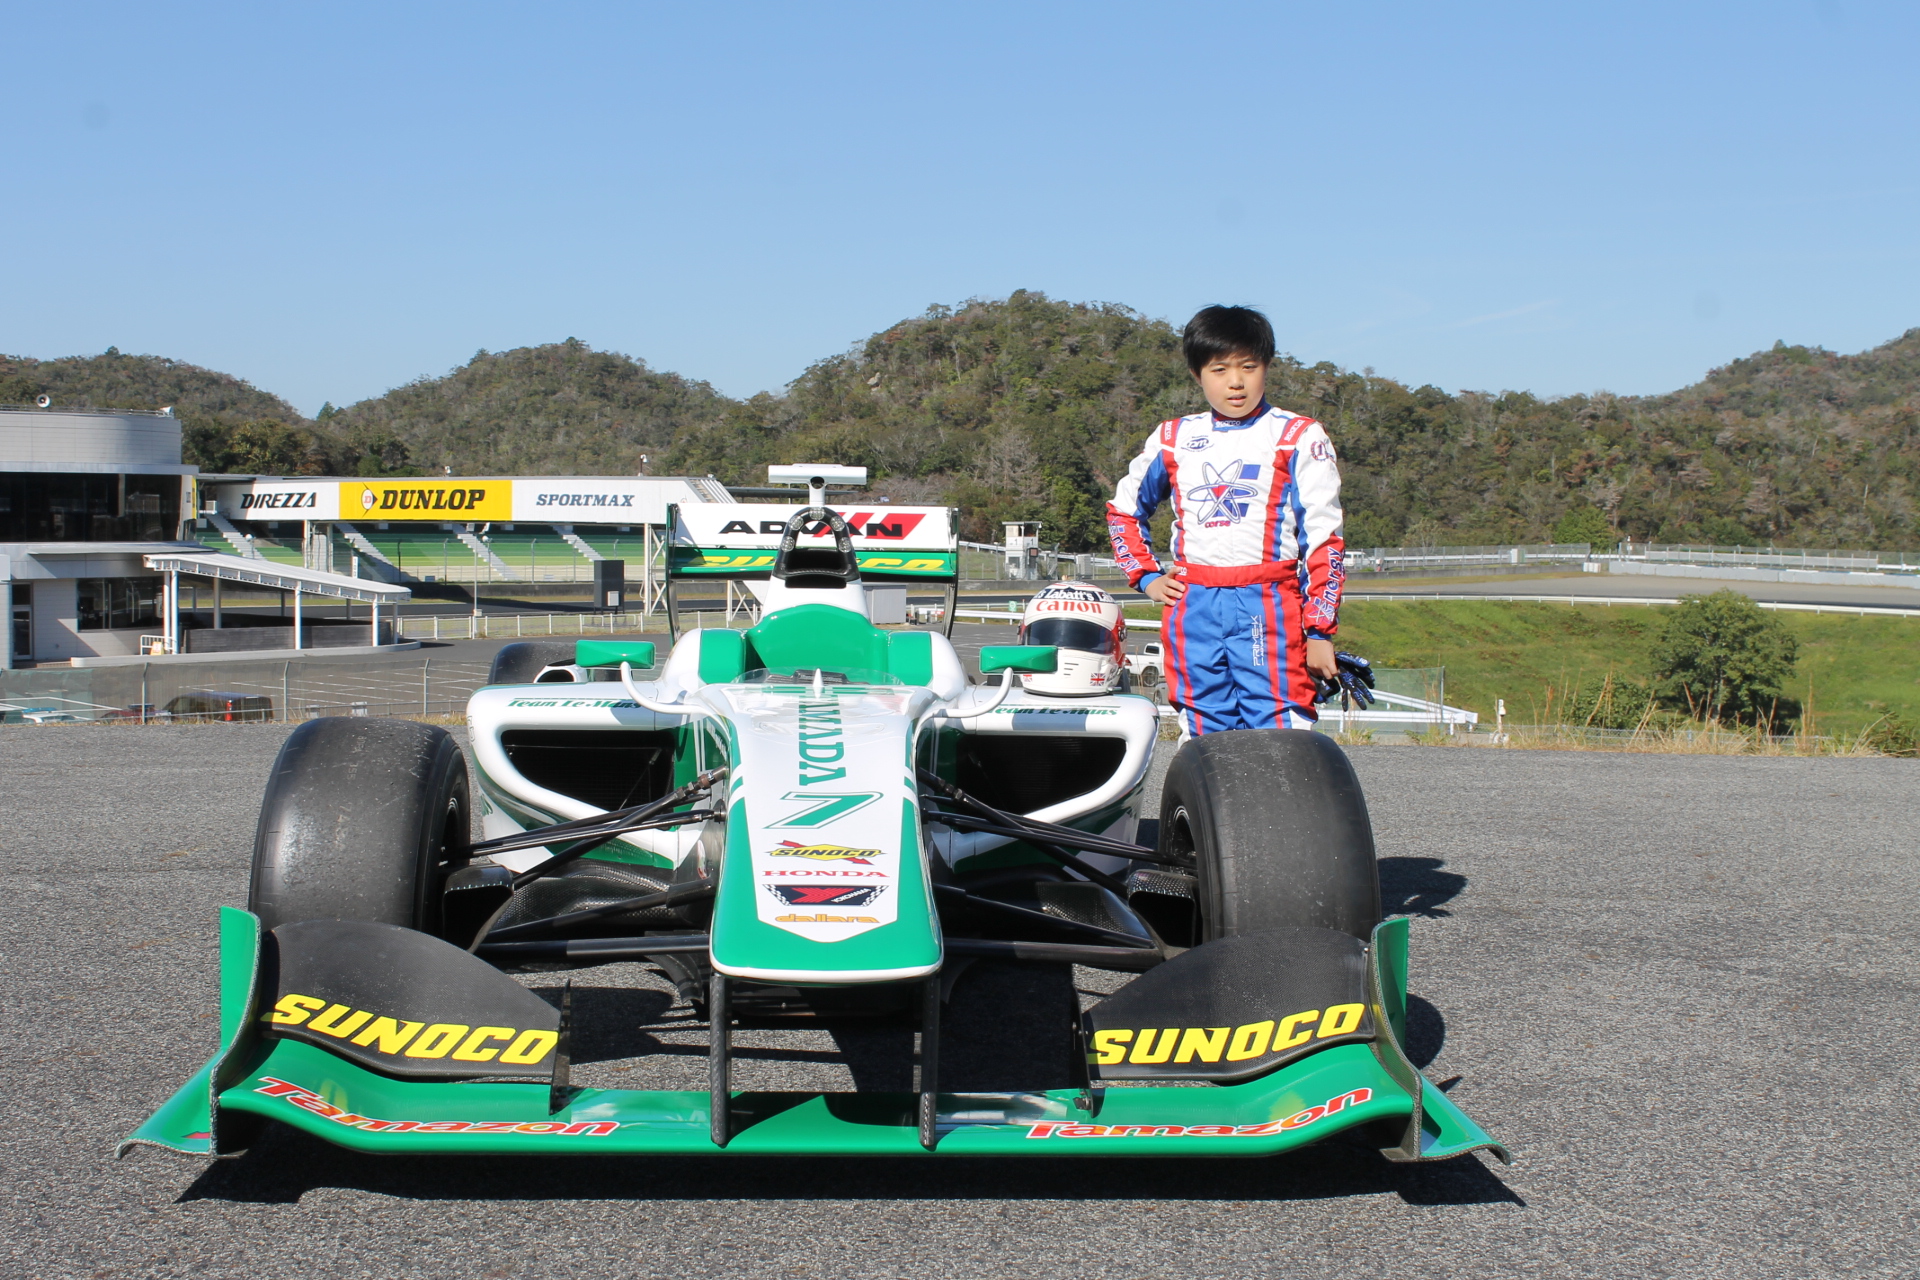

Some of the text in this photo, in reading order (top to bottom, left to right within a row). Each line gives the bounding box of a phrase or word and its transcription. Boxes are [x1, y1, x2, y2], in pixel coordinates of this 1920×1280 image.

[240, 491, 317, 509] DIREZZA
[379, 488, 485, 510] DUNLOP
[536, 493, 635, 507] SPORTMAX
[687, 555, 945, 570] SUCO
[1044, 588, 1095, 602] Labatt's
[987, 706, 1033, 714] eam
[763, 791, 885, 830] 7
[775, 848, 877, 857] SUNOCO
[775, 913, 880, 923] dallara
[261, 993, 559, 1065] SUNOCO
[1088, 1003, 1366, 1065] SUNOCO
[254, 1076, 620, 1136] Tamazon
[1026, 1087, 1373, 1139] Tamazon
